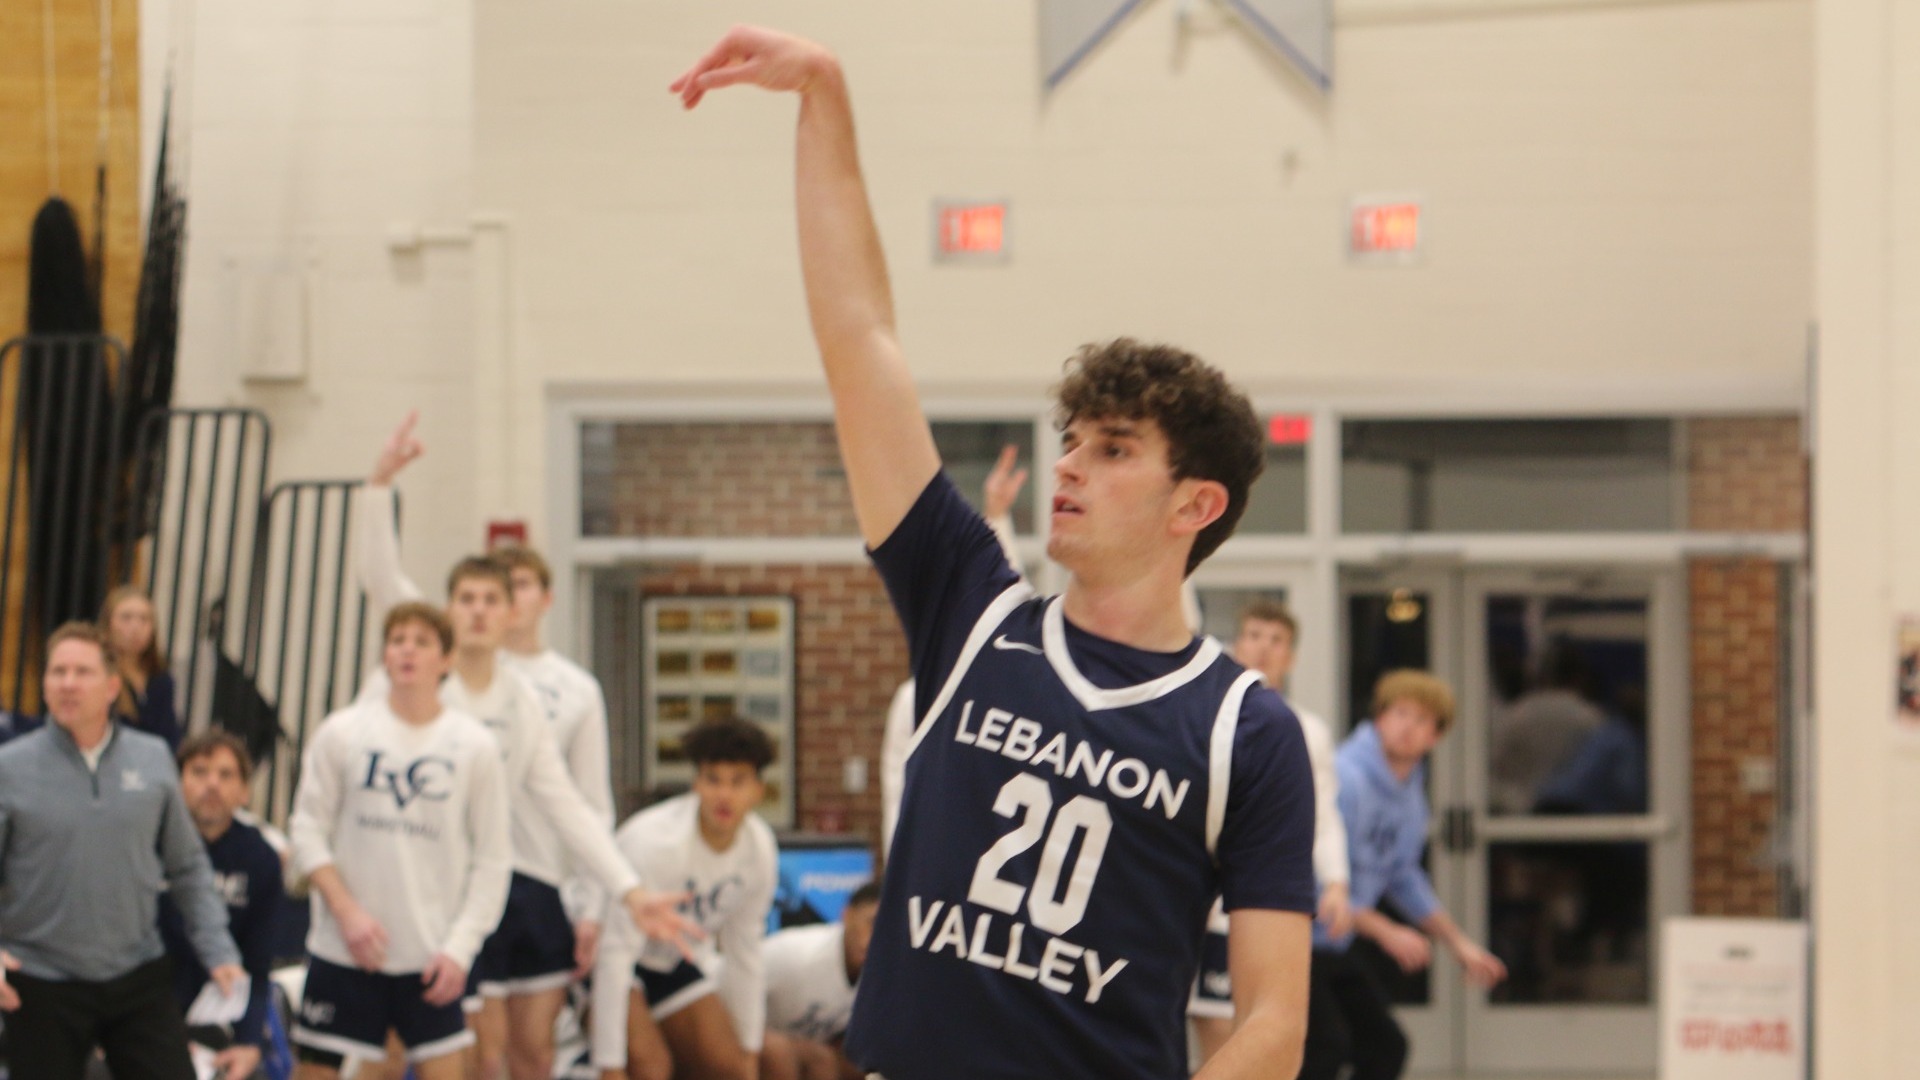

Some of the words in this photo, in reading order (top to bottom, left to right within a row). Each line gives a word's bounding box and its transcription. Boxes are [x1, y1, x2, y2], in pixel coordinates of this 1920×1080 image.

[361, 750, 455, 810] LVC
[954, 699, 1190, 820] LEBANON
[967, 772, 1113, 936] 20
[908, 895, 1129, 1004] VALLEY
